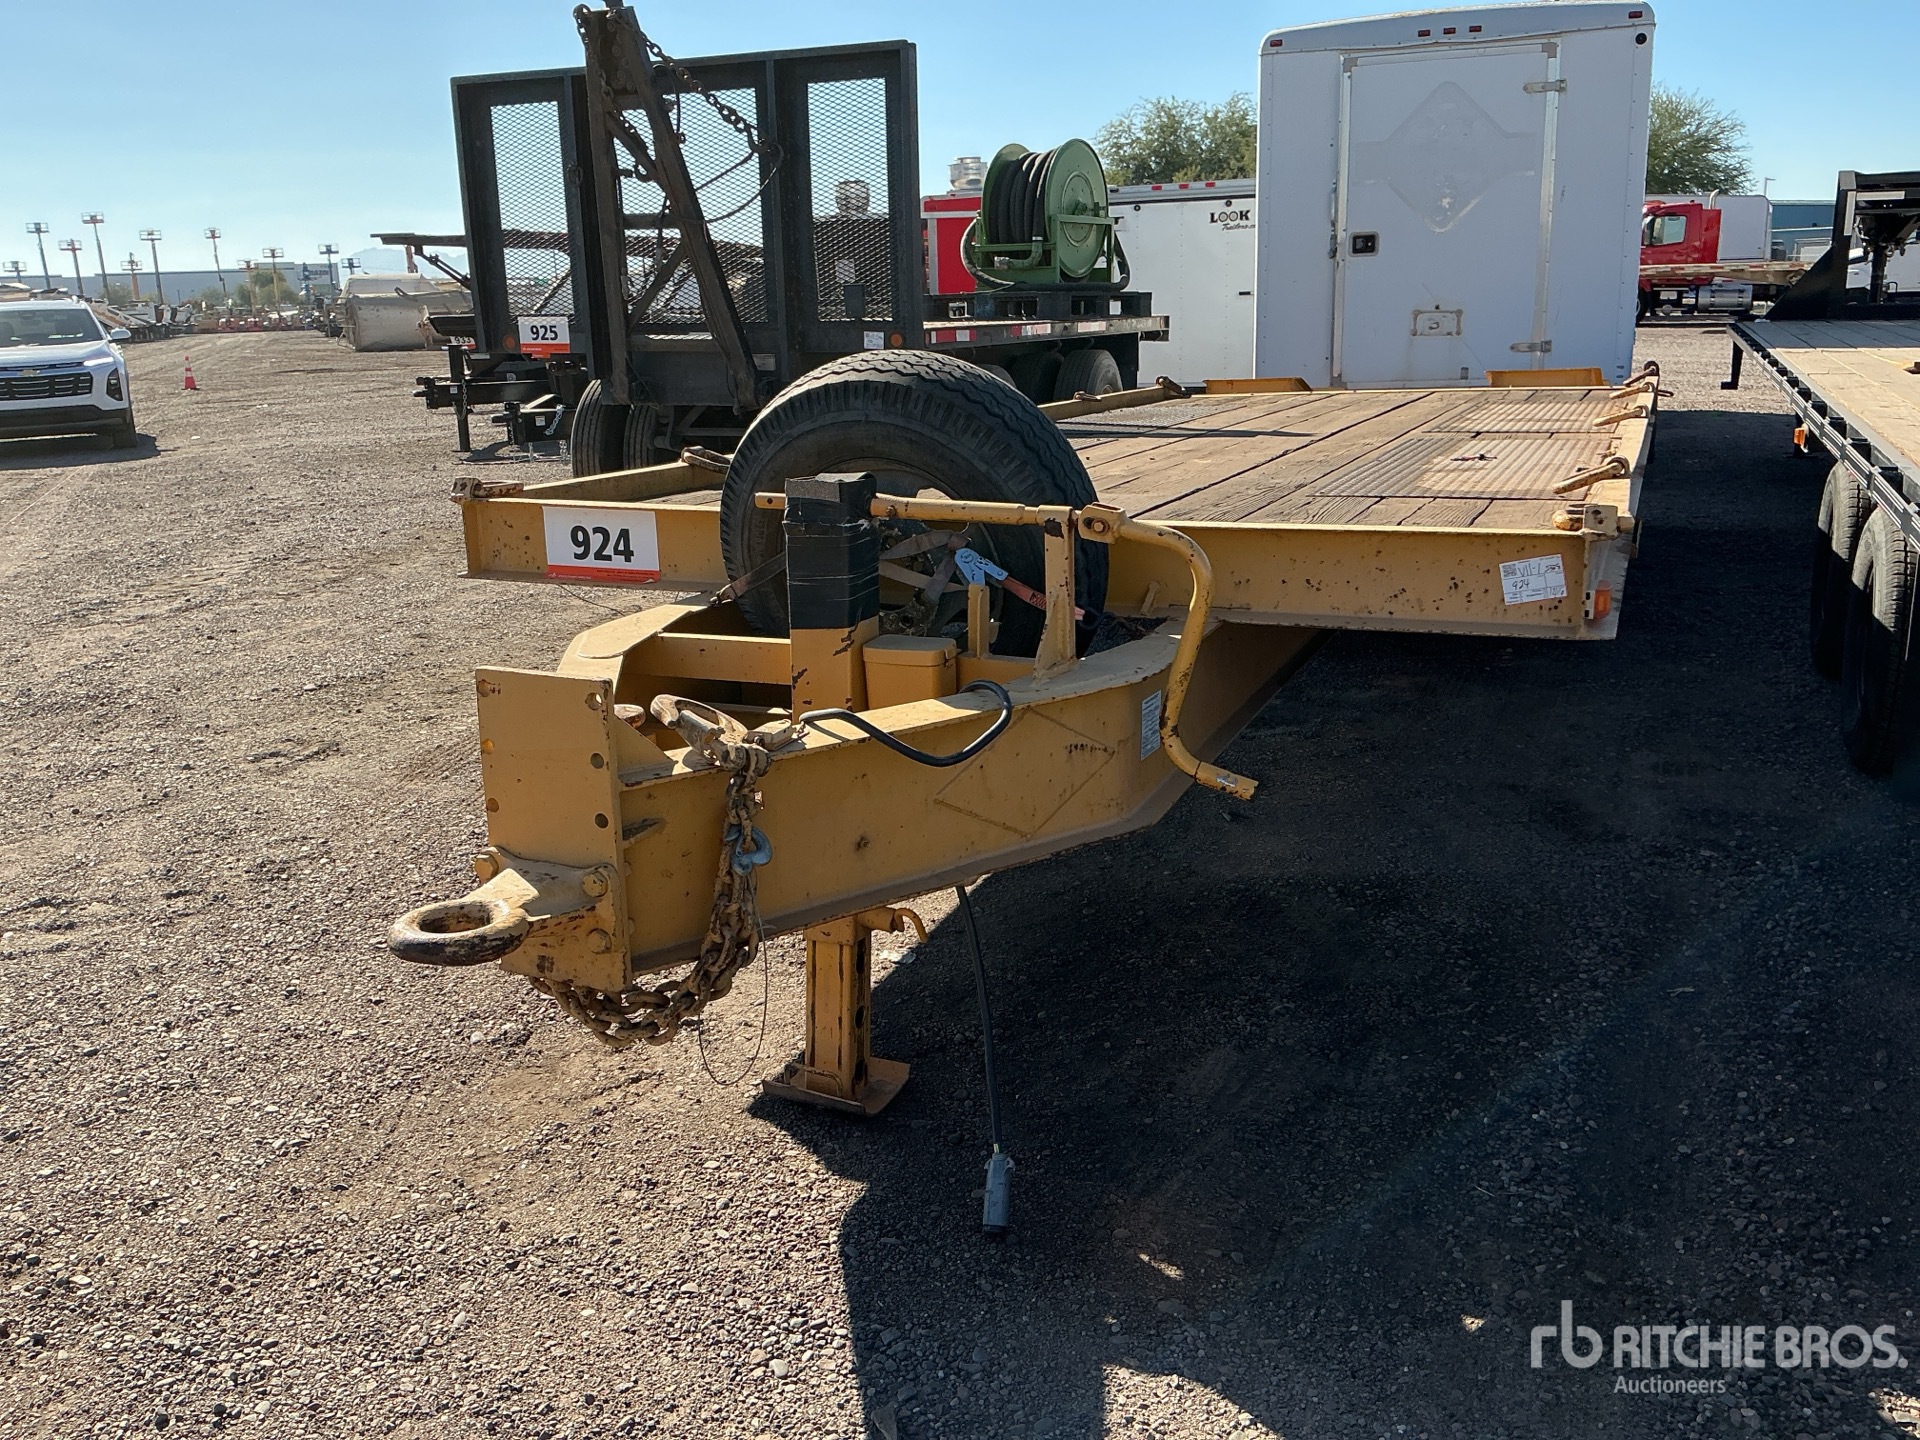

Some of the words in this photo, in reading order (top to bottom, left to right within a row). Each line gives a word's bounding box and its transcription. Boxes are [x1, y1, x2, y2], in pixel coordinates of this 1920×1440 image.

[1209, 210, 1251, 224] LOOK
[530, 325, 558, 341] 925
[570, 525, 635, 563] 924
[1512, 578, 1531, 591] 924
